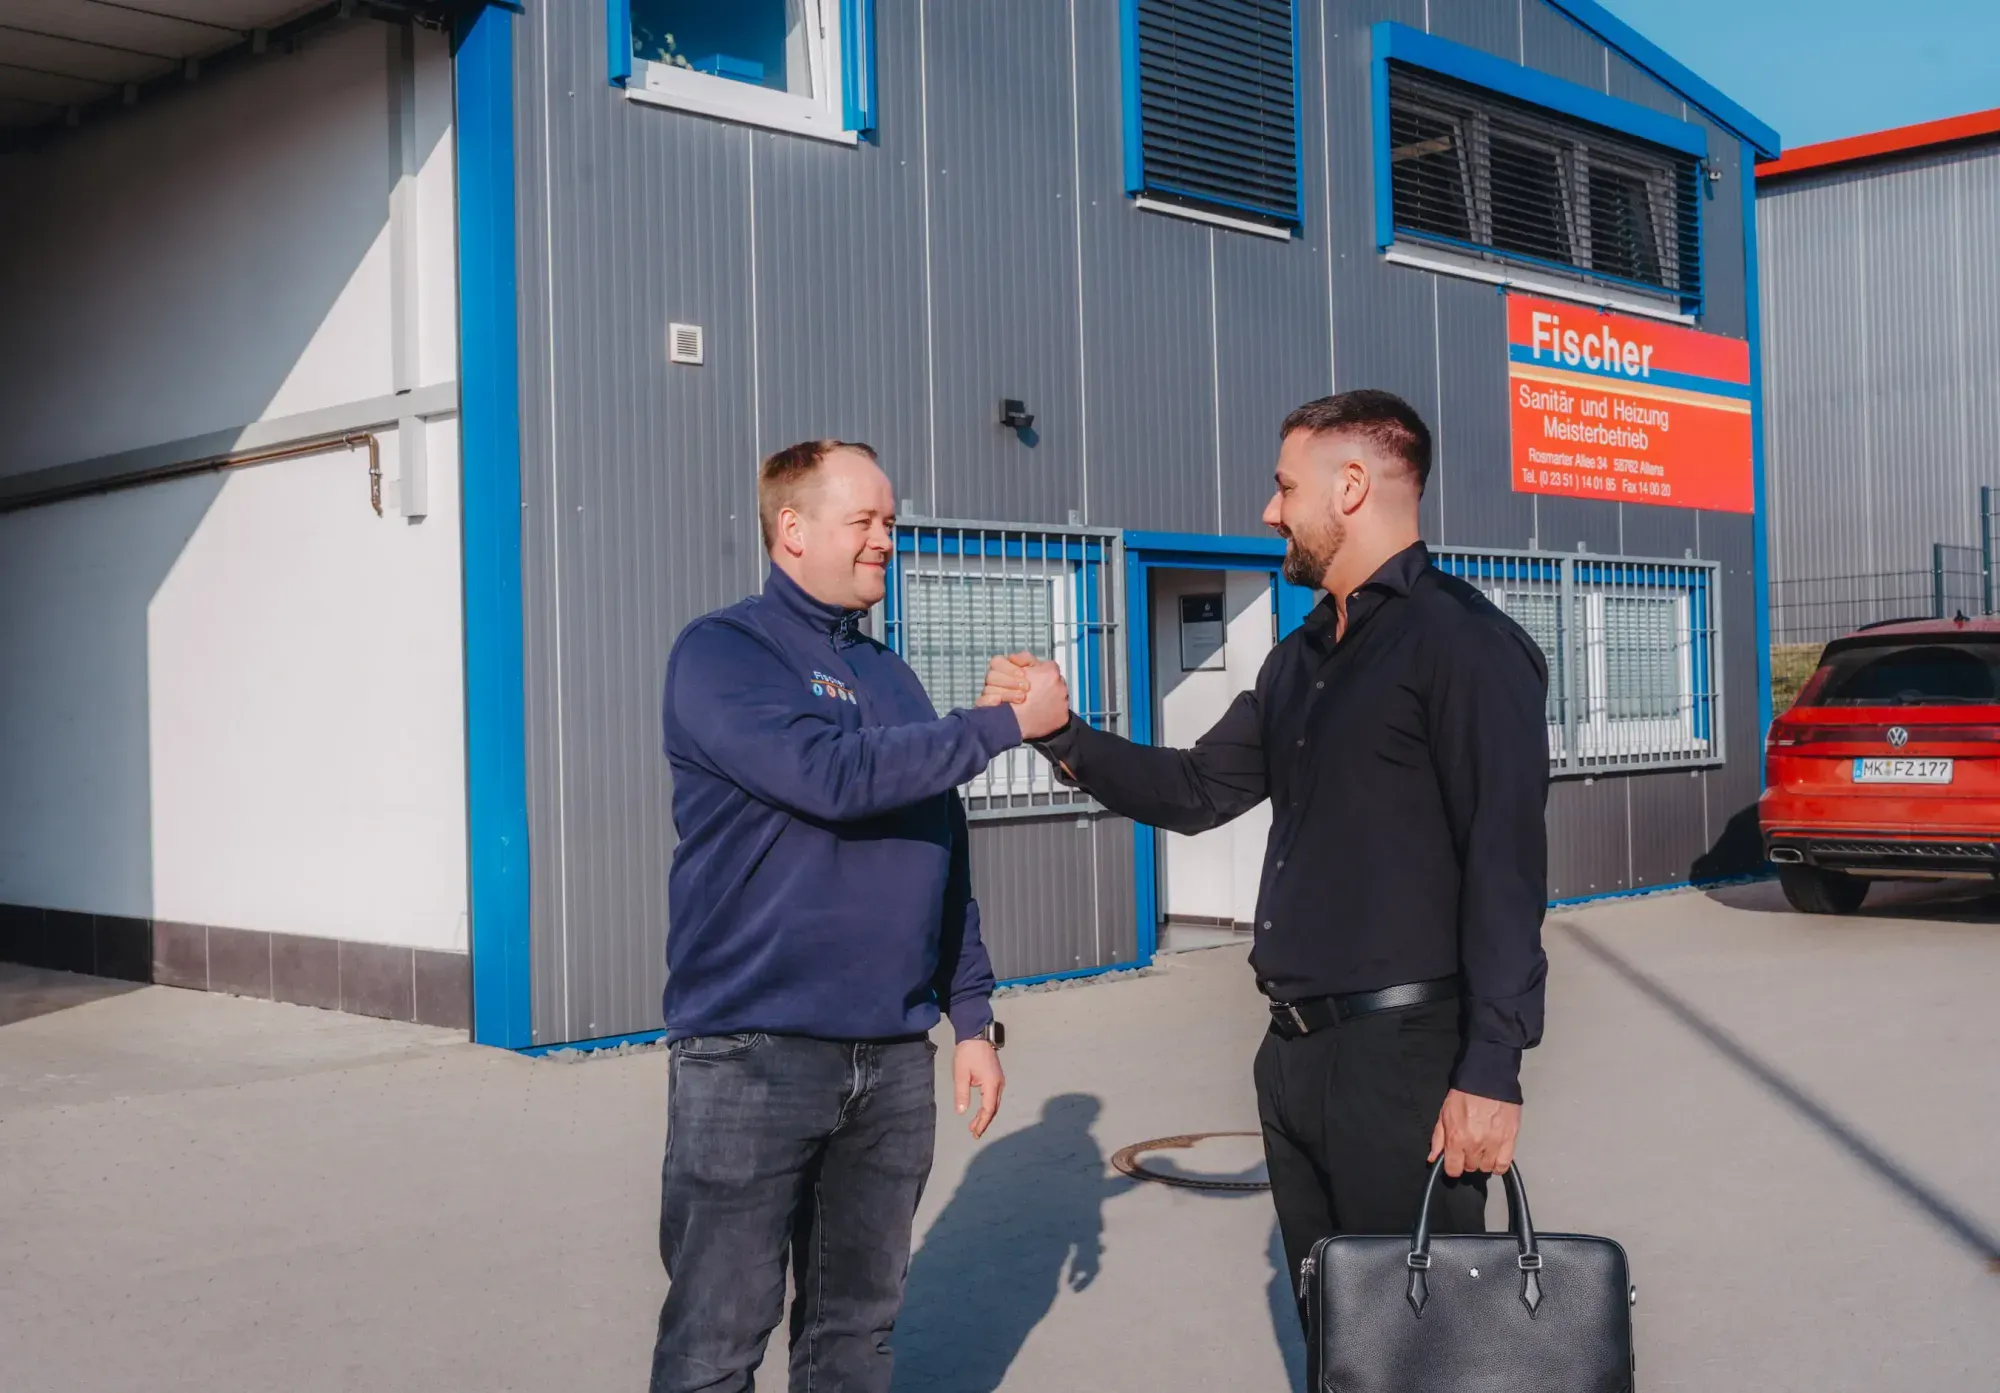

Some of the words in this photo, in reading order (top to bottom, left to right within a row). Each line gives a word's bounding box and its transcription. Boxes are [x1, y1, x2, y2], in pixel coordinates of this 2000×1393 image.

[1532, 311, 1653, 377] Fischer
[1519, 384, 1575, 414] Sanitär
[1580, 396, 1608, 419] und
[1613, 398, 1669, 432] Heizung
[1543, 415, 1649, 450] Meisterbetrieb
[1596, 455, 1608, 470] 34
[1622, 478, 1638, 494] Fax
[1863, 761, 1884, 776] MK
